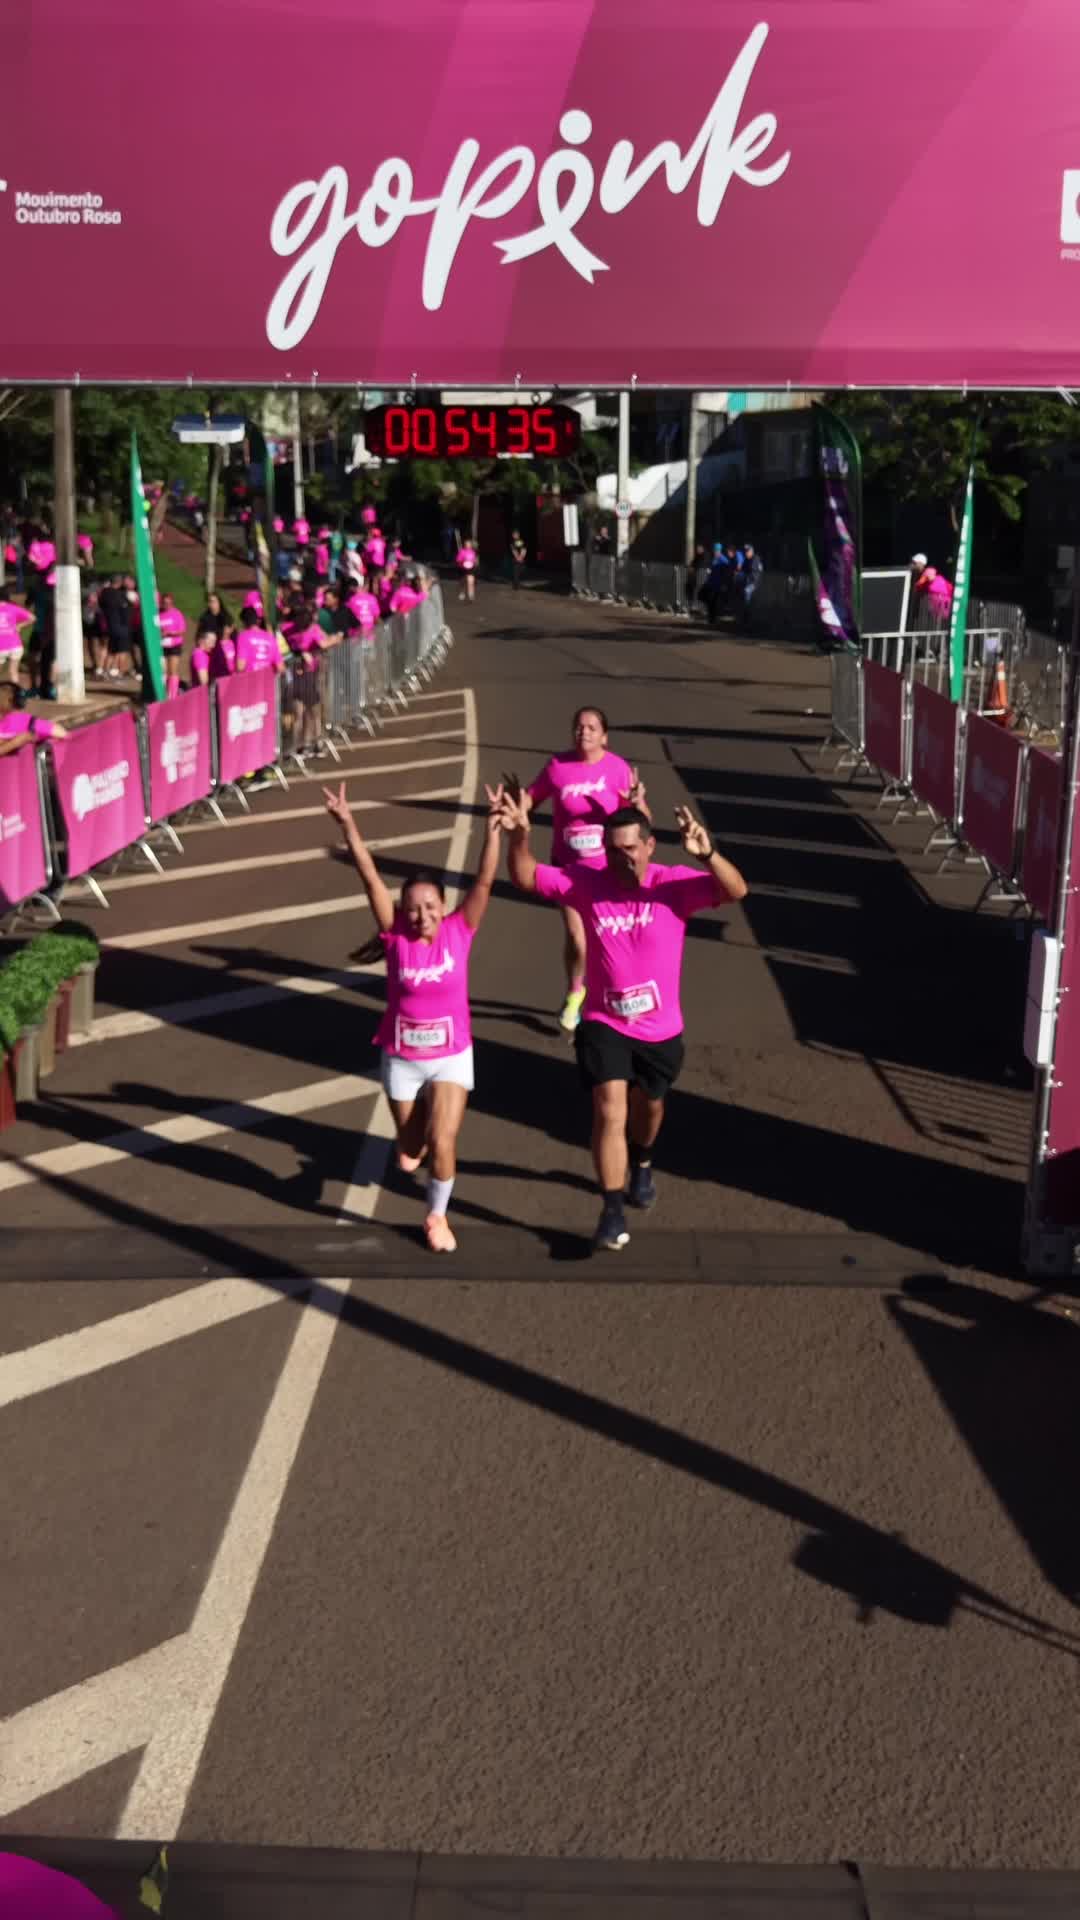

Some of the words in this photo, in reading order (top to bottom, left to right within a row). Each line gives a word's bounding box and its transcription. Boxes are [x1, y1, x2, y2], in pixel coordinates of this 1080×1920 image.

[15, 207, 81, 224] Outubro
[83, 208, 122, 225] Rosa
[266, 21, 791, 351] gopink
